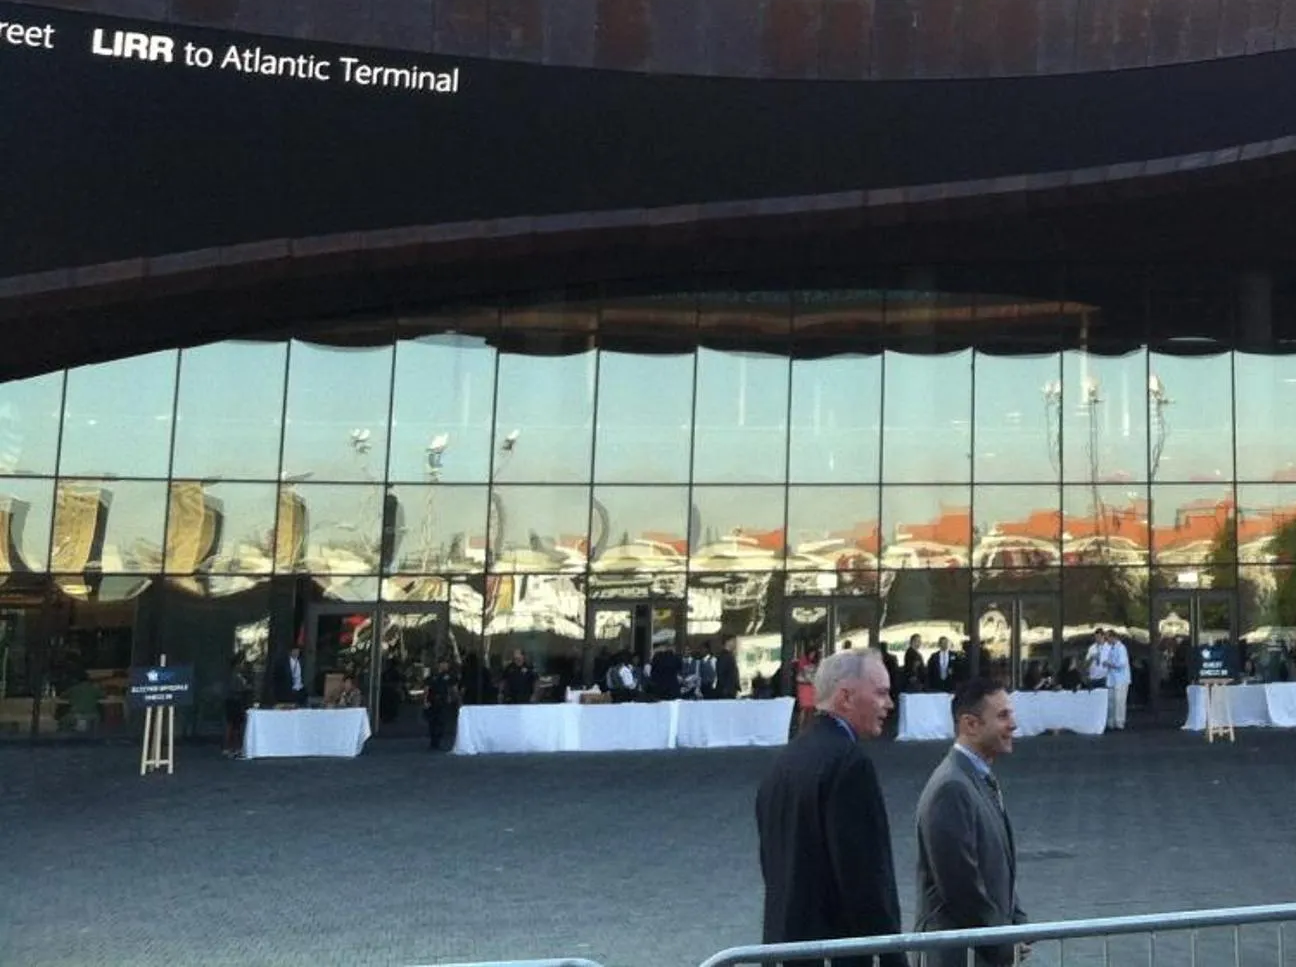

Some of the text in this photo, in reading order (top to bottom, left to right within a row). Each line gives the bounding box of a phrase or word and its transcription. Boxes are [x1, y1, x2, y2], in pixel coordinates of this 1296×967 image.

[92, 29, 174, 63] LIRR
[184, 43, 214, 68] to
[221, 45, 331, 81] Atlantic
[339, 57, 459, 94] Terminal
